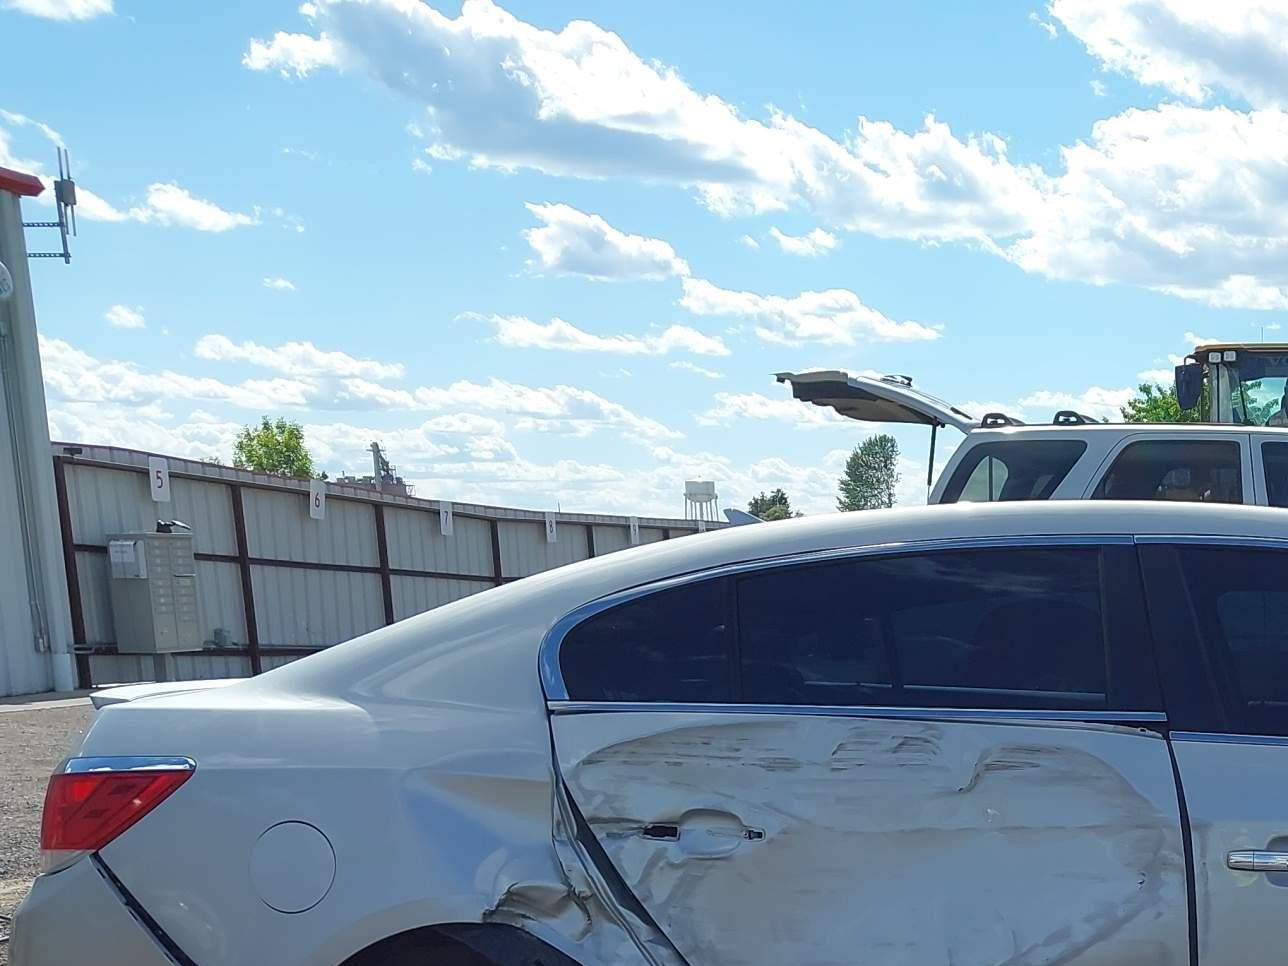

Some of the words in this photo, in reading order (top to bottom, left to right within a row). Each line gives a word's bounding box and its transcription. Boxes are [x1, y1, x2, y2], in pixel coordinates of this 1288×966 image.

[156, 470, 164, 488] 5
[314, 492, 321, 508] 6
[443, 510, 450, 525] 7
[549, 520, 554, 533] 8
